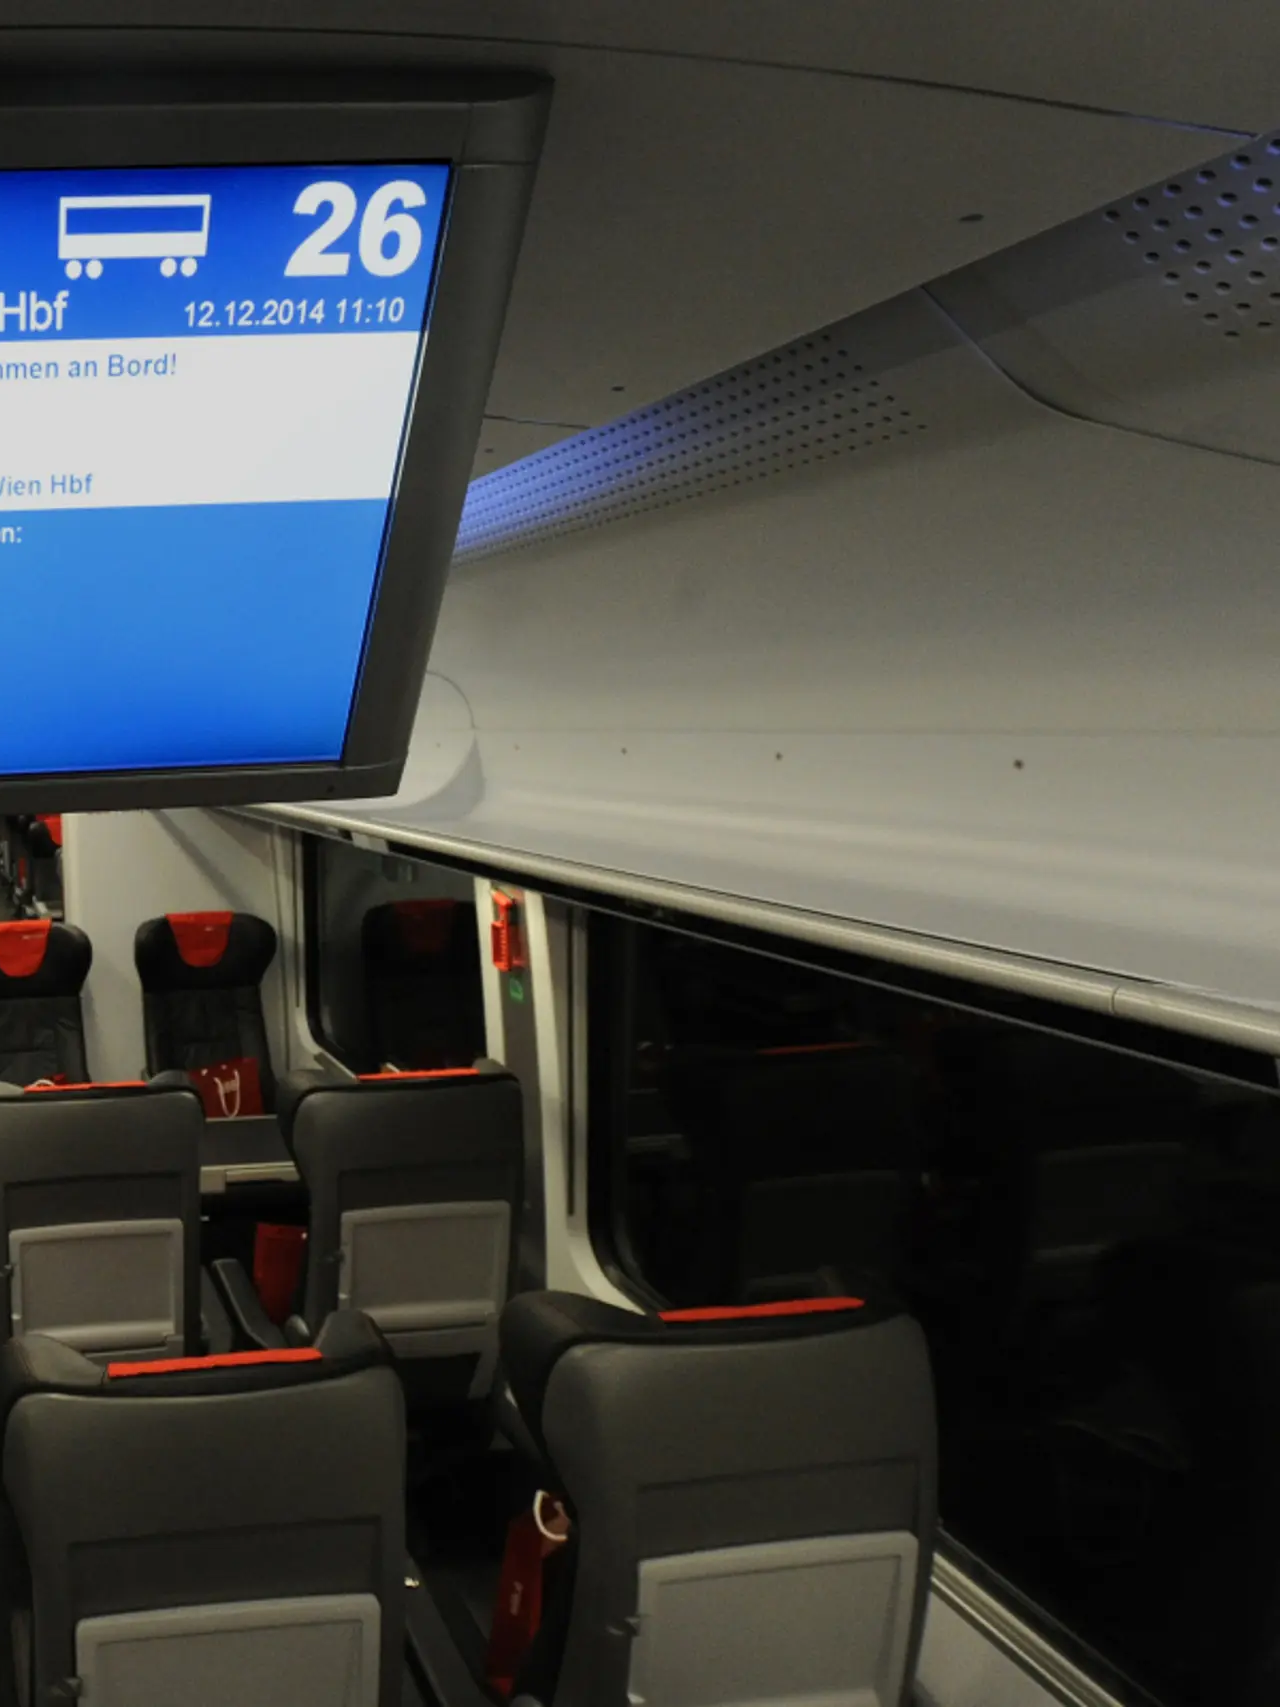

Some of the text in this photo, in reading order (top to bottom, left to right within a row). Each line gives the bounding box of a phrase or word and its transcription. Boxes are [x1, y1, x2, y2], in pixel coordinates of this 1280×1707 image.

[283, 180, 426, 277] 26
[185, 297, 405, 327] 12.12.2014 11:10
[69, 360, 98, 377] an
[107, 353, 176, 377] Bord!
[51, 473, 93, 494] Hbf
